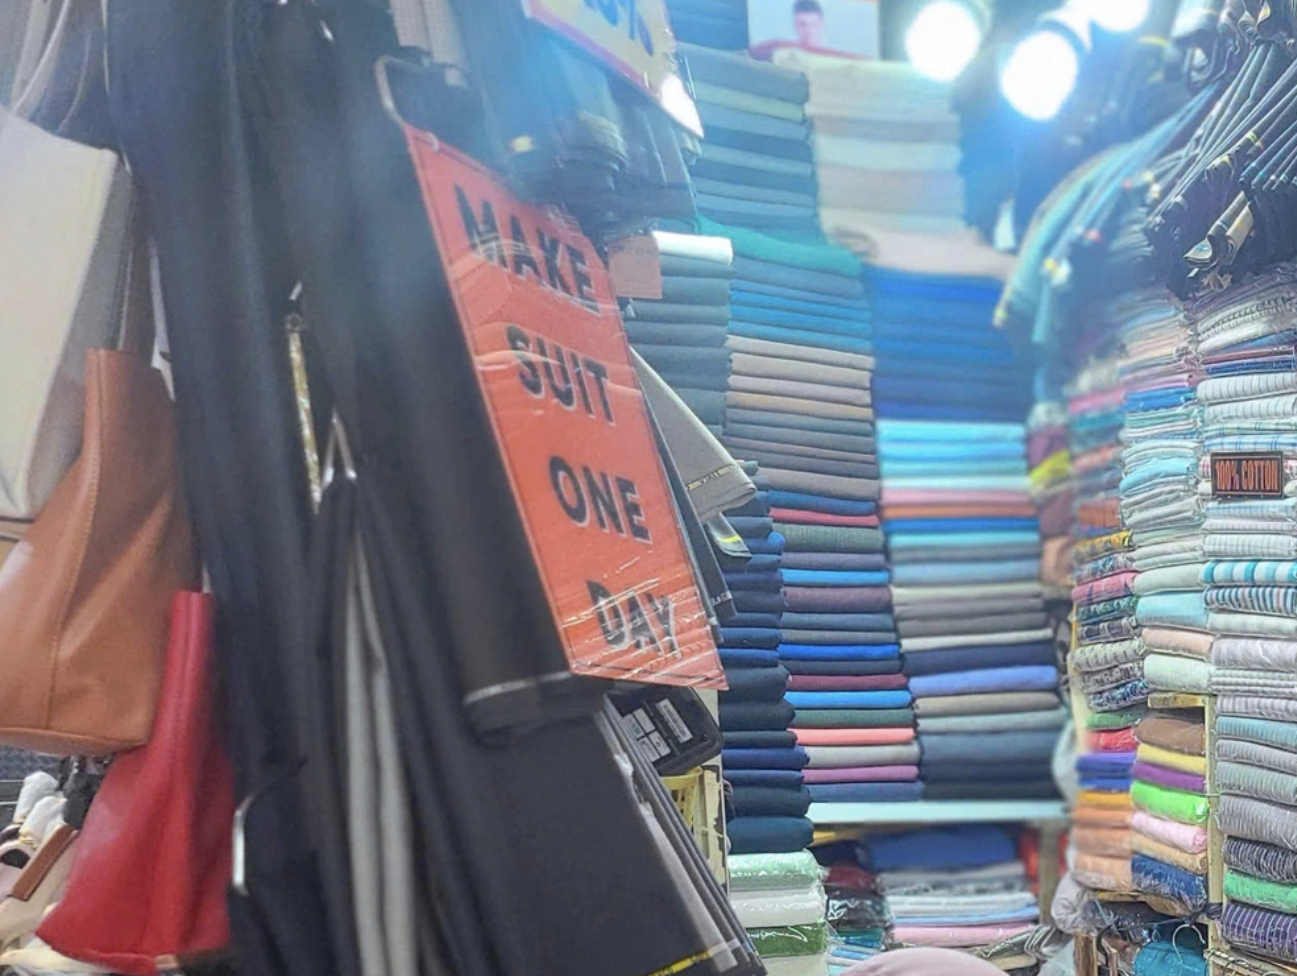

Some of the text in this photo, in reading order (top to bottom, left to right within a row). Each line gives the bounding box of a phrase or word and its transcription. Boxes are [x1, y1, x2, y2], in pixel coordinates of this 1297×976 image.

[454, 183, 602, 317] MAKE
[506, 324, 616, 427] SUIT
[548, 455, 654, 545] ONE
[1215, 460, 1279, 490] 100% COTTON
[586, 579, 682, 659] DAY
